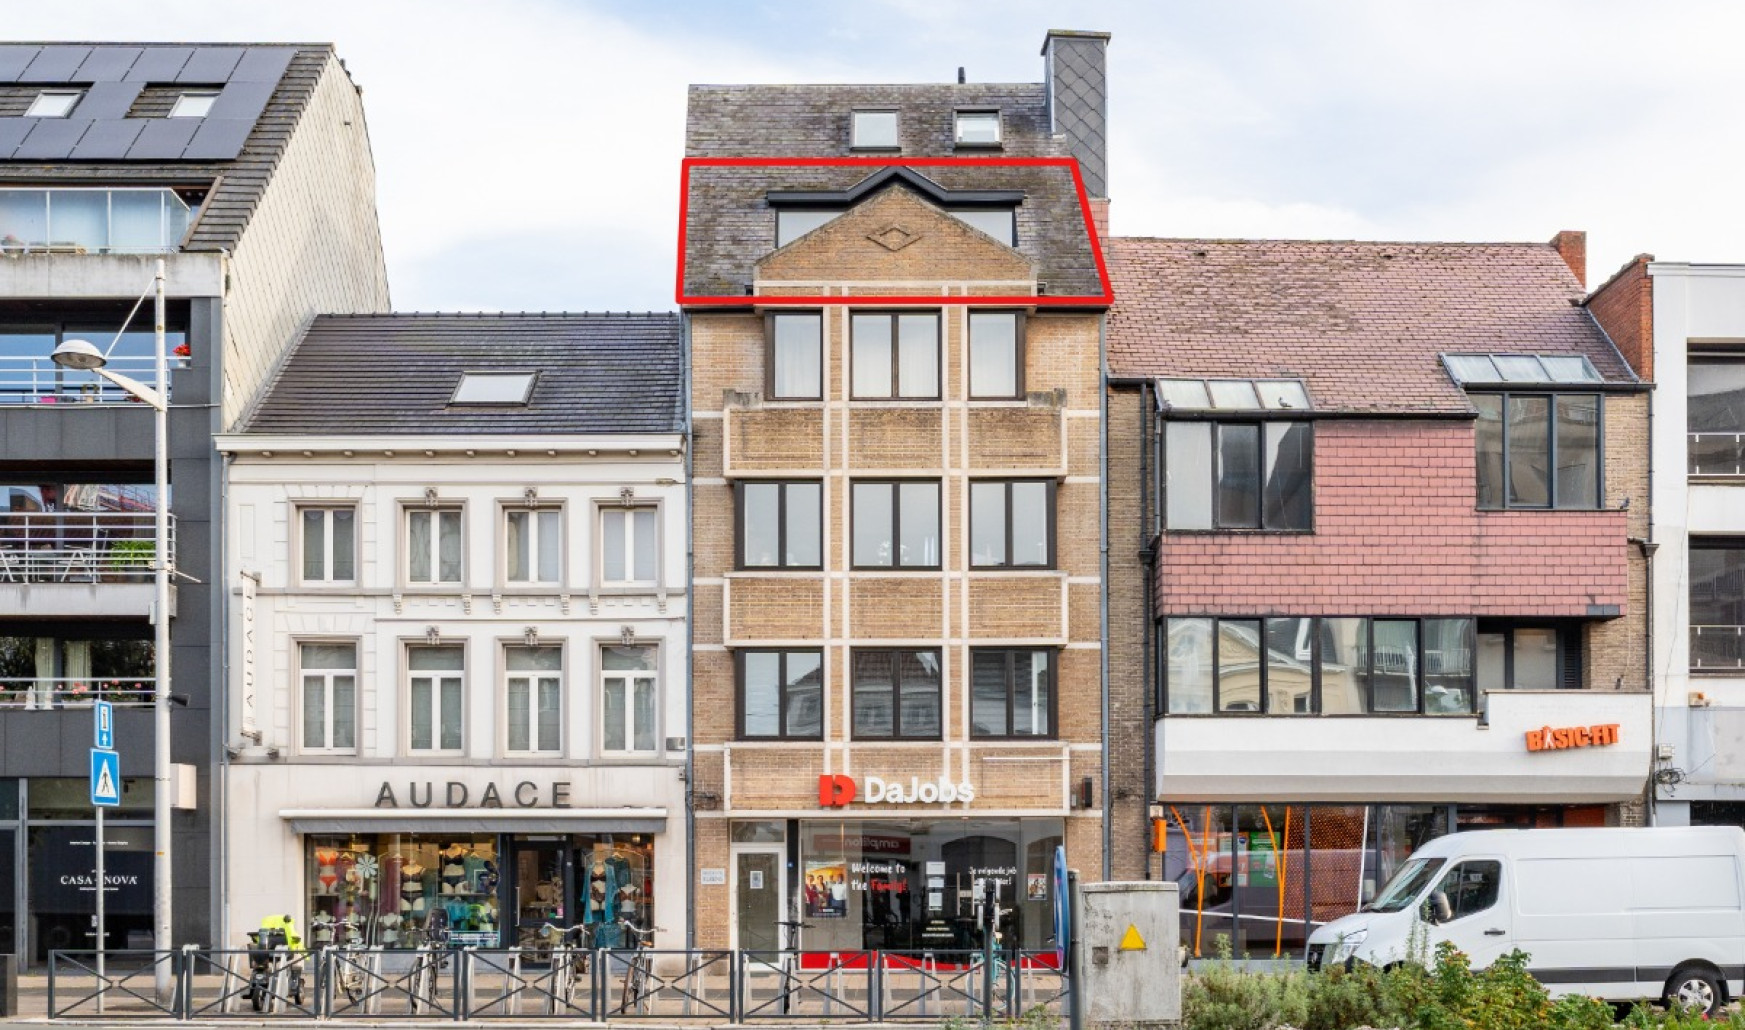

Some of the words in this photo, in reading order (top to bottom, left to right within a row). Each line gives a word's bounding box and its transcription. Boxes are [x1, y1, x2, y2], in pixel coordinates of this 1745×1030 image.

[374, 781, 571, 808] AUDACE
[864, 776, 975, 804] DaJobs
[851, 862, 893, 874] Welcome
[896, 863, 906, 874] to
[60, 875, 93, 885] CASA
[104, 875, 137, 885] NOVA
[851, 879, 868, 891] the
